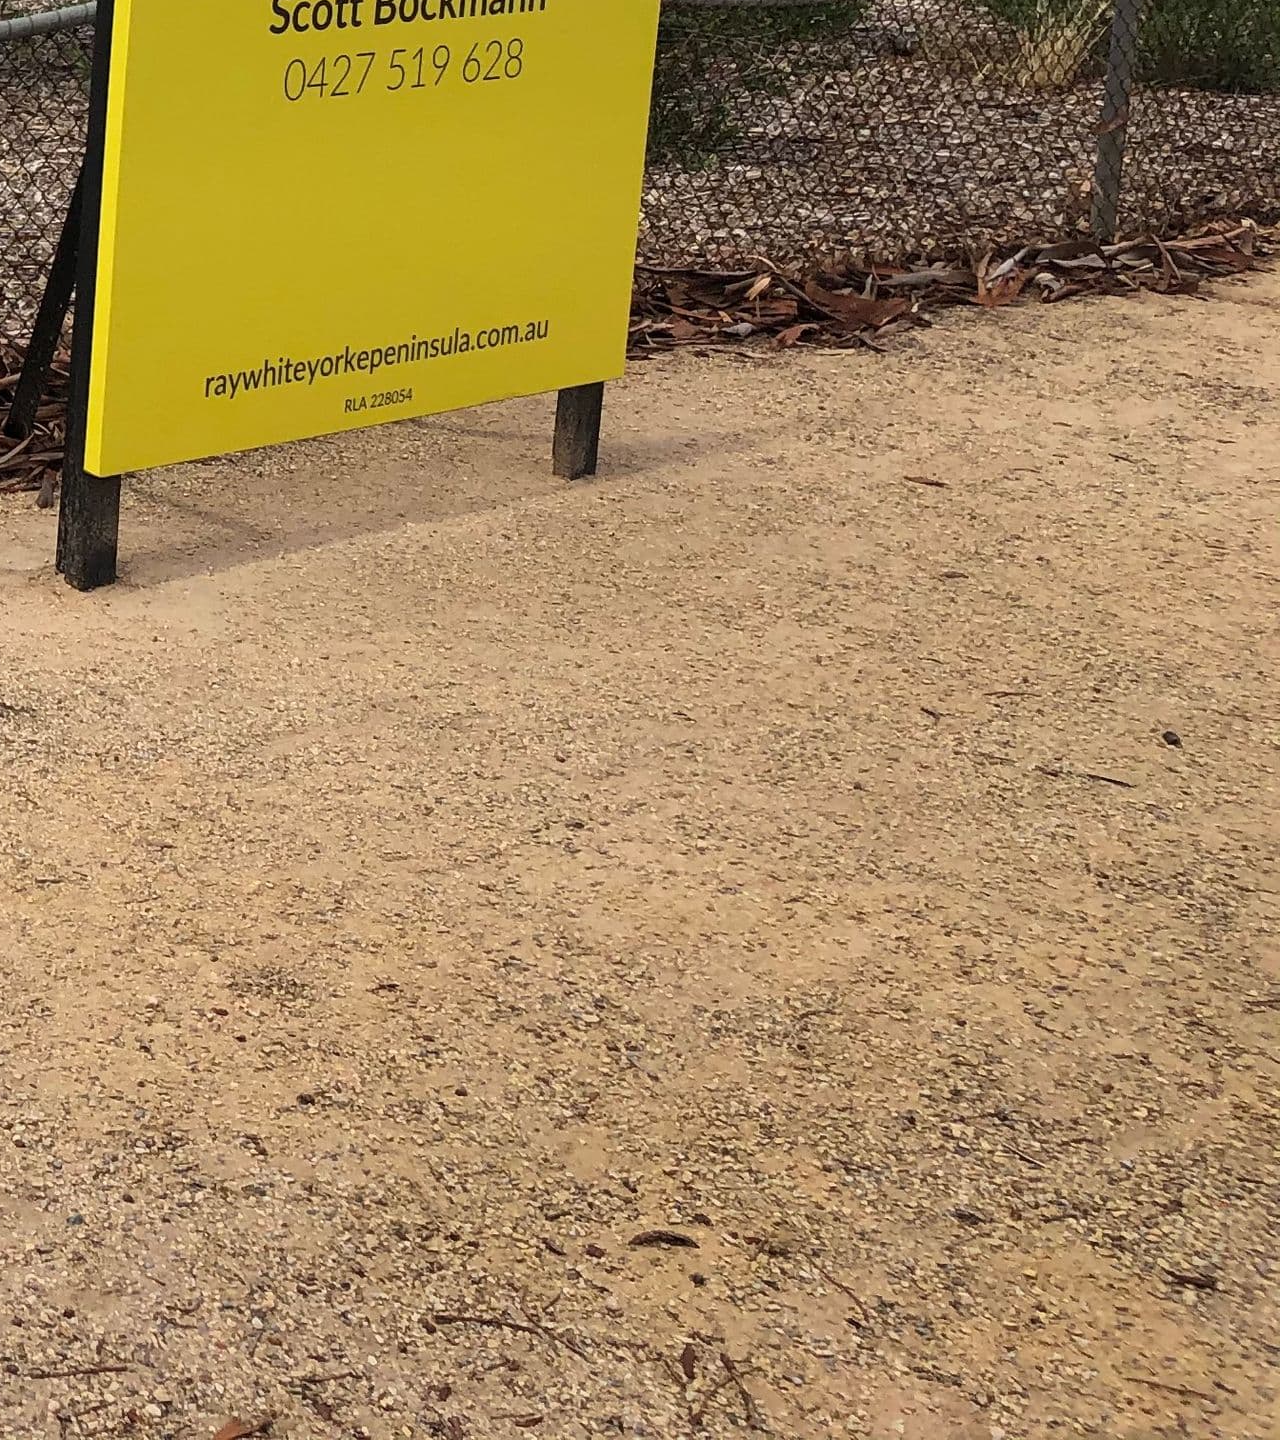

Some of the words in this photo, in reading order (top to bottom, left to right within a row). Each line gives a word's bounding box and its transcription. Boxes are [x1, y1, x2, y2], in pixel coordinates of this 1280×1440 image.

[284, 52, 375, 101] 0427
[386, 45, 450, 91] 519
[462, 38, 524, 83] 628
[204, 319, 549, 398] raywhiteyorkepeninsula.com.au
[344, 396, 367, 413] RLA
[370, 388, 413, 408] 228054
